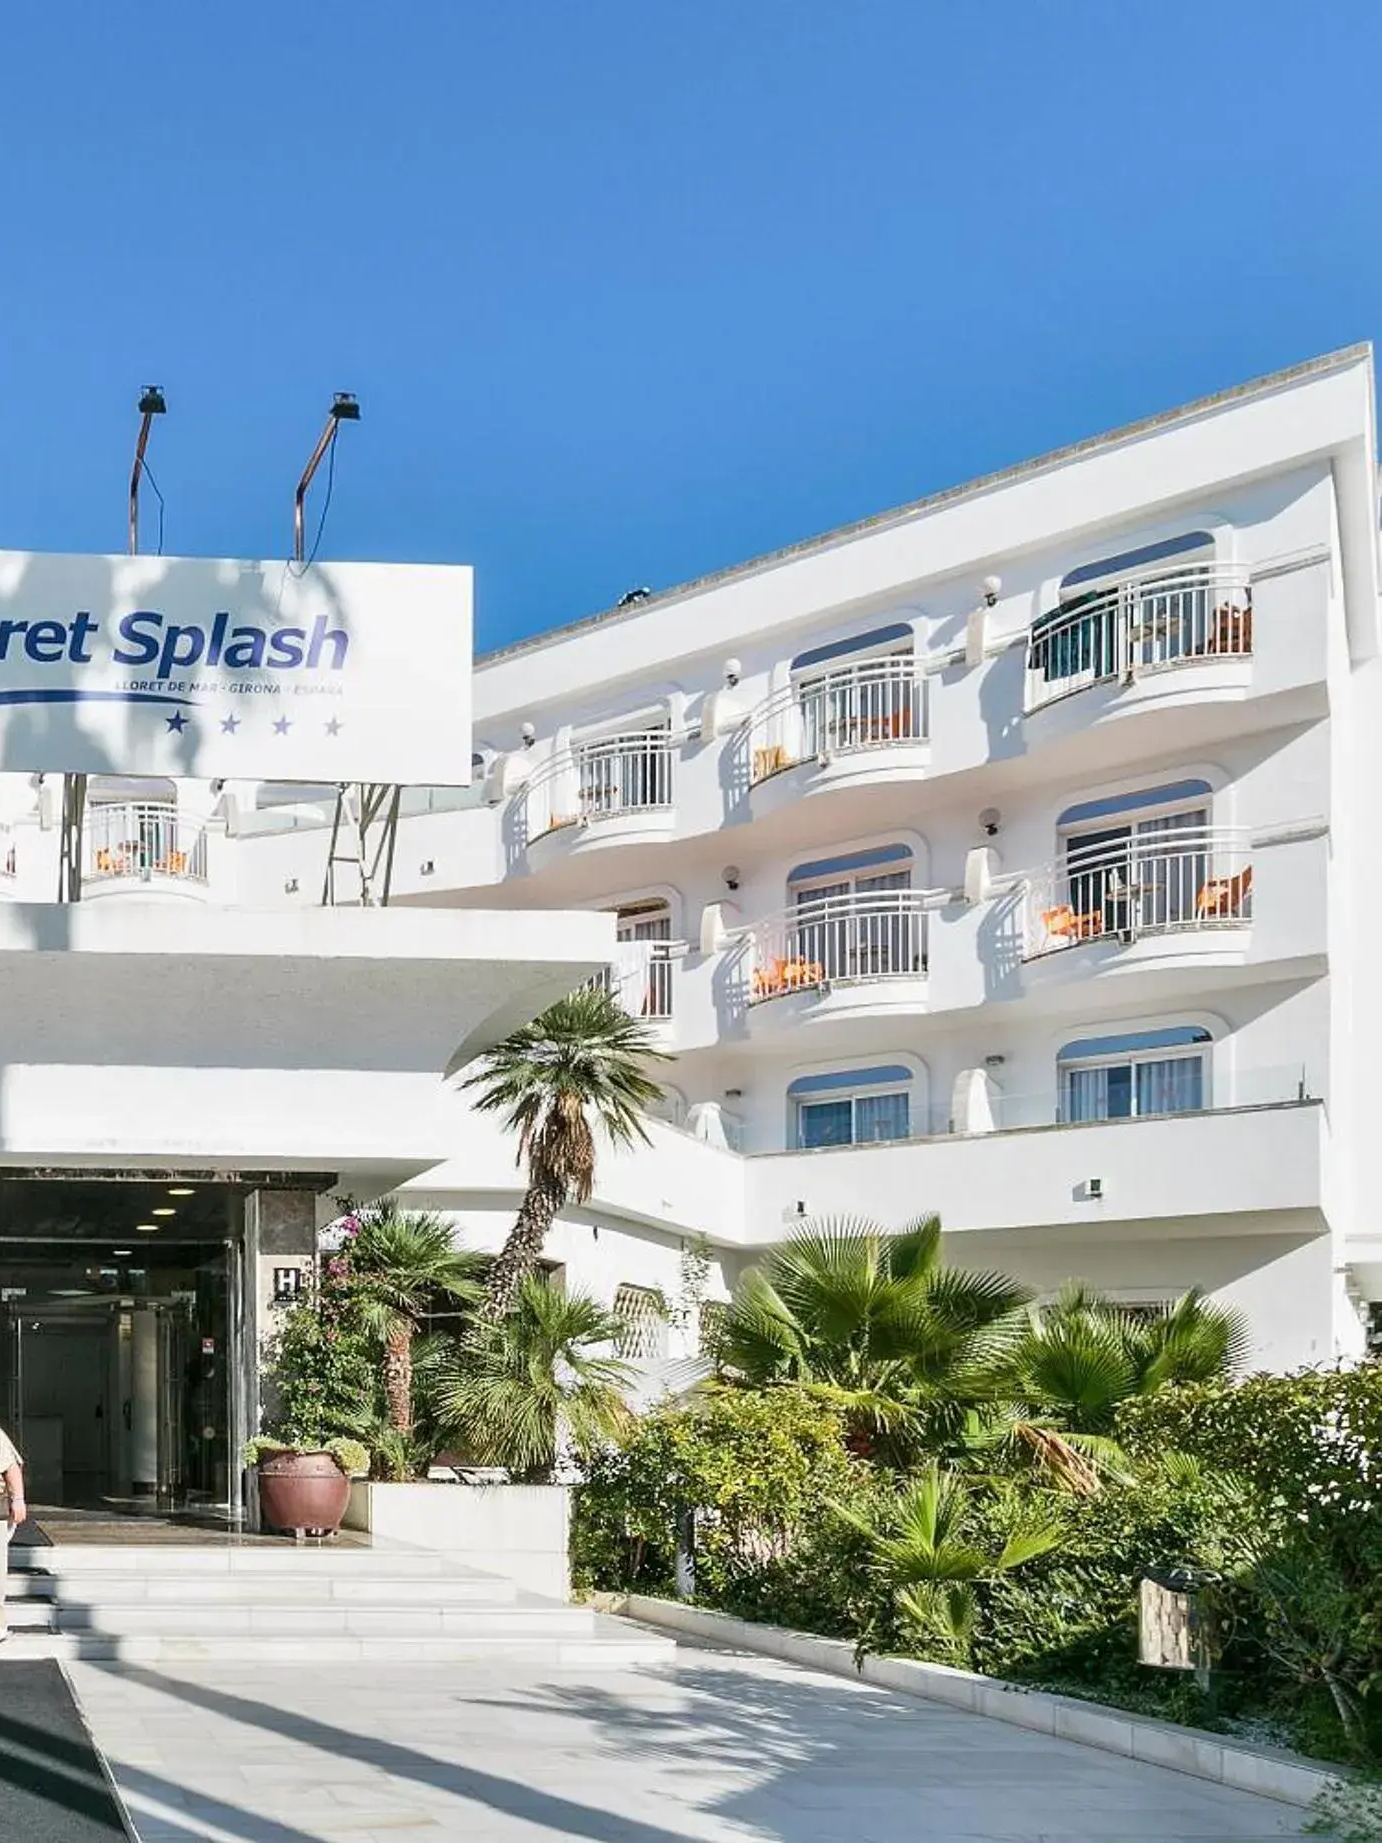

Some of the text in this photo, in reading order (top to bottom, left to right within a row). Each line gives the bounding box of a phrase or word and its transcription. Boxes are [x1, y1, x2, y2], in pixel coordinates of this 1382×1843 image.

[113, 611, 349, 679] Splash
[115, 680, 164, 692] LLORET
[167, 681, 186, 693] DE
[189, 682, 218, 693] MAR
[229, 683, 281, 695] GIRONA
[278, 1269, 296, 1291] H
